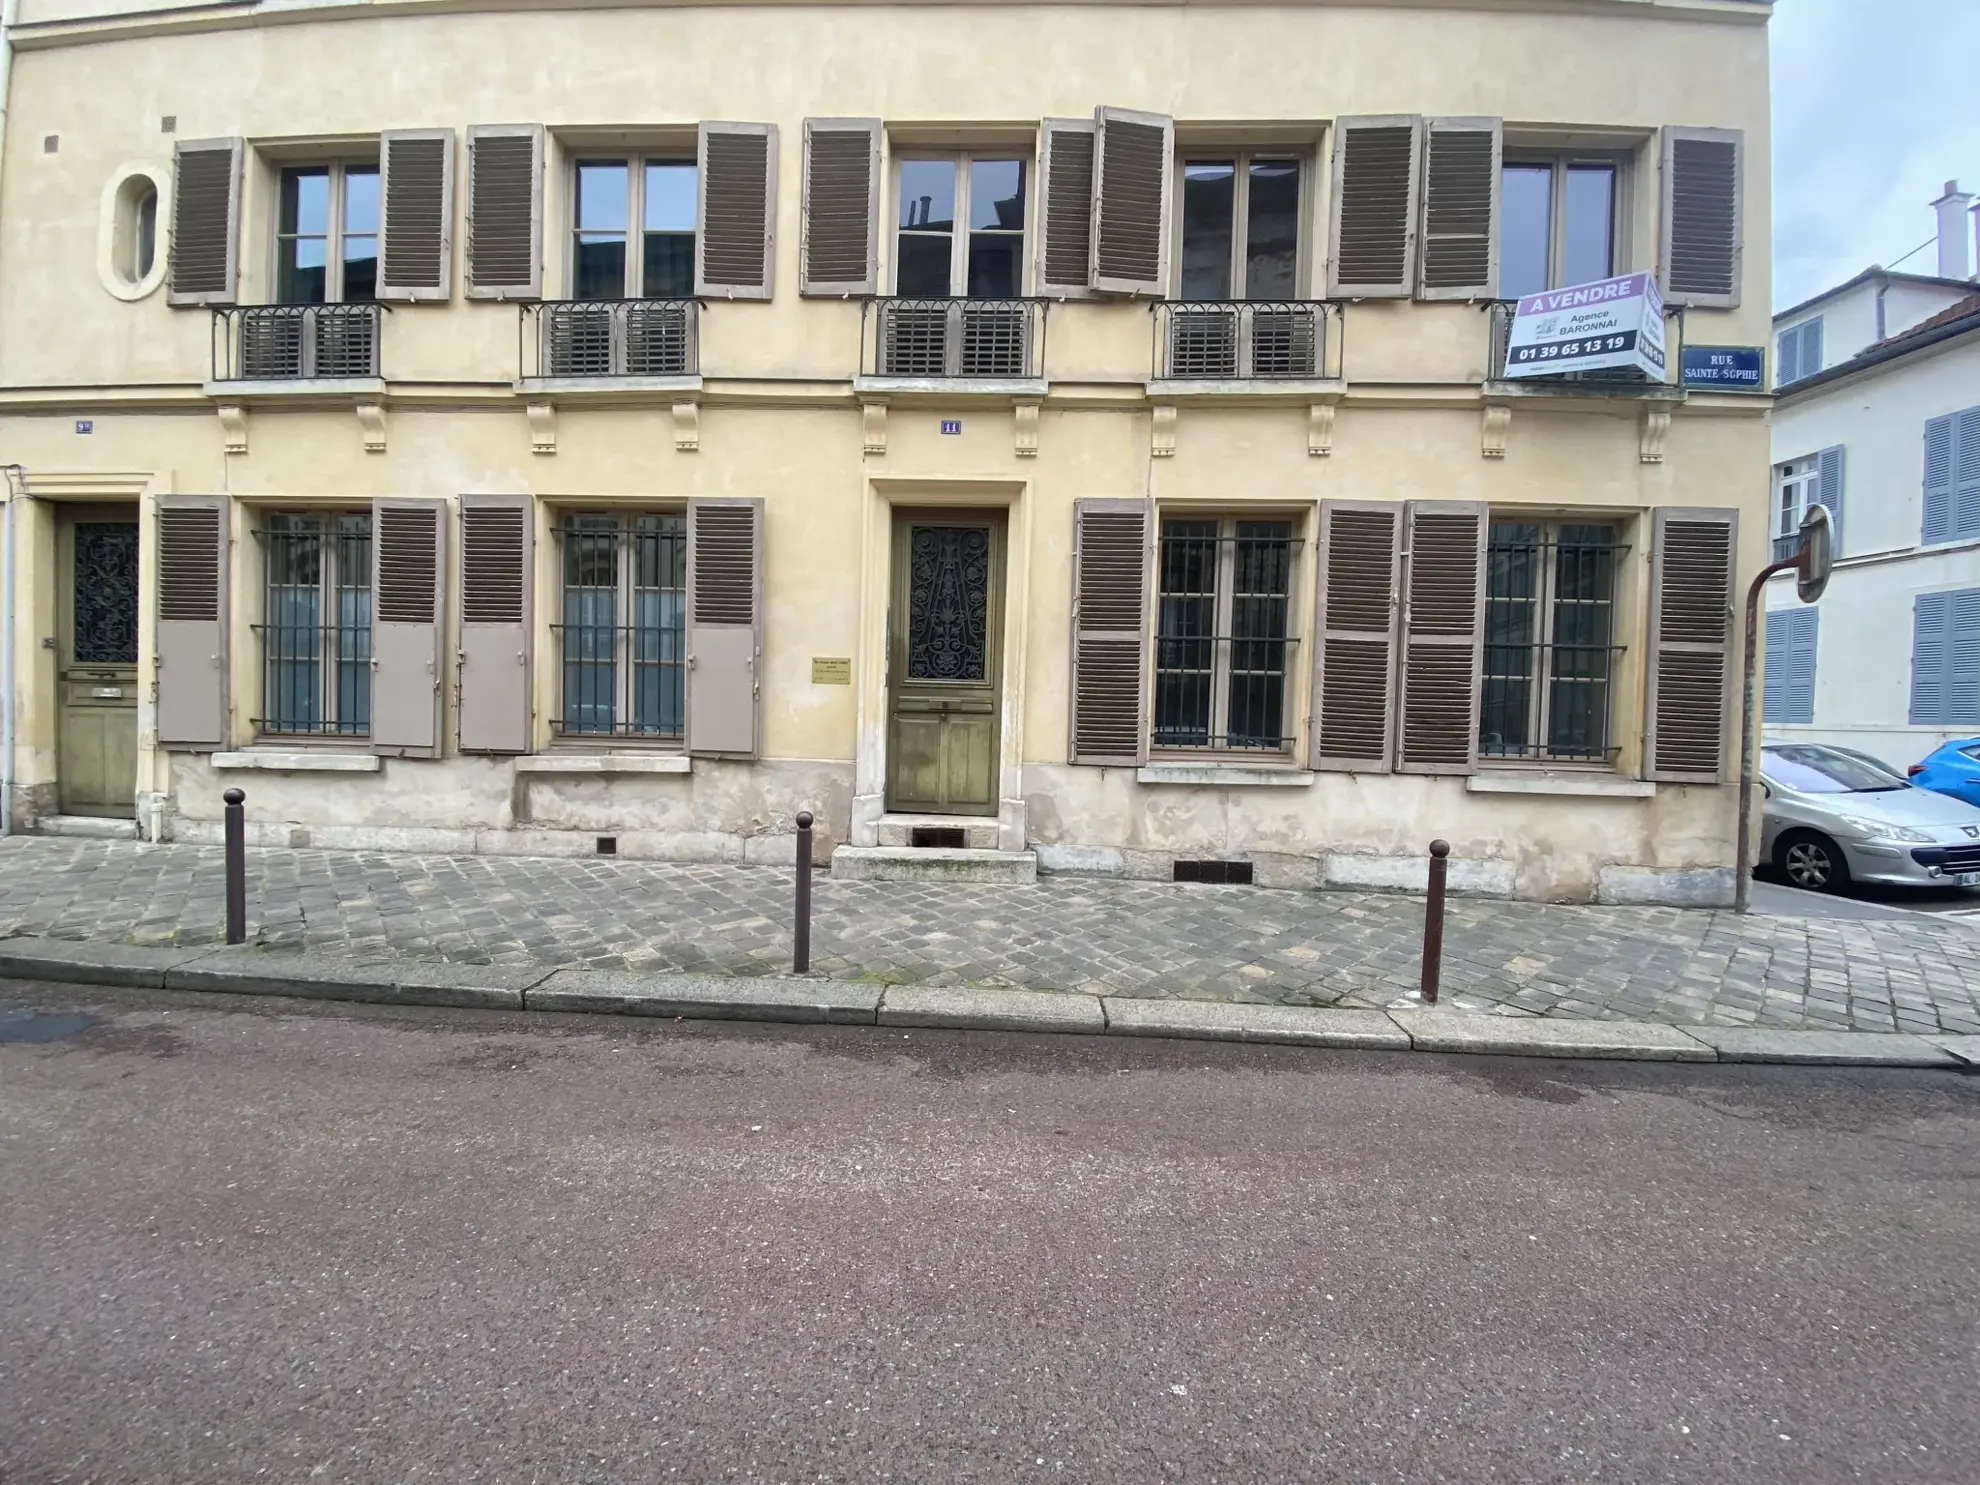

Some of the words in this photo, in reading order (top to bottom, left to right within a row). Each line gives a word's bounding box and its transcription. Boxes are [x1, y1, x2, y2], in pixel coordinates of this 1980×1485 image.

[1530, 300, 1544, 313] A
[1548, 280, 1632, 309] VENDRE
[1570, 310, 1609, 324] Agence
[1559, 319, 1618, 336] BARONNAI
[1519, 348, 1536, 360] 01
[1540, 346, 1558, 358] 39
[1561, 342, 1580, 355] 65
[1584, 339, 1602, 352] 13
[1606, 336, 1625, 349] 19
[1710, 355, 1733, 365] RUE
[1684, 368, 1719, 379] SAINTE
